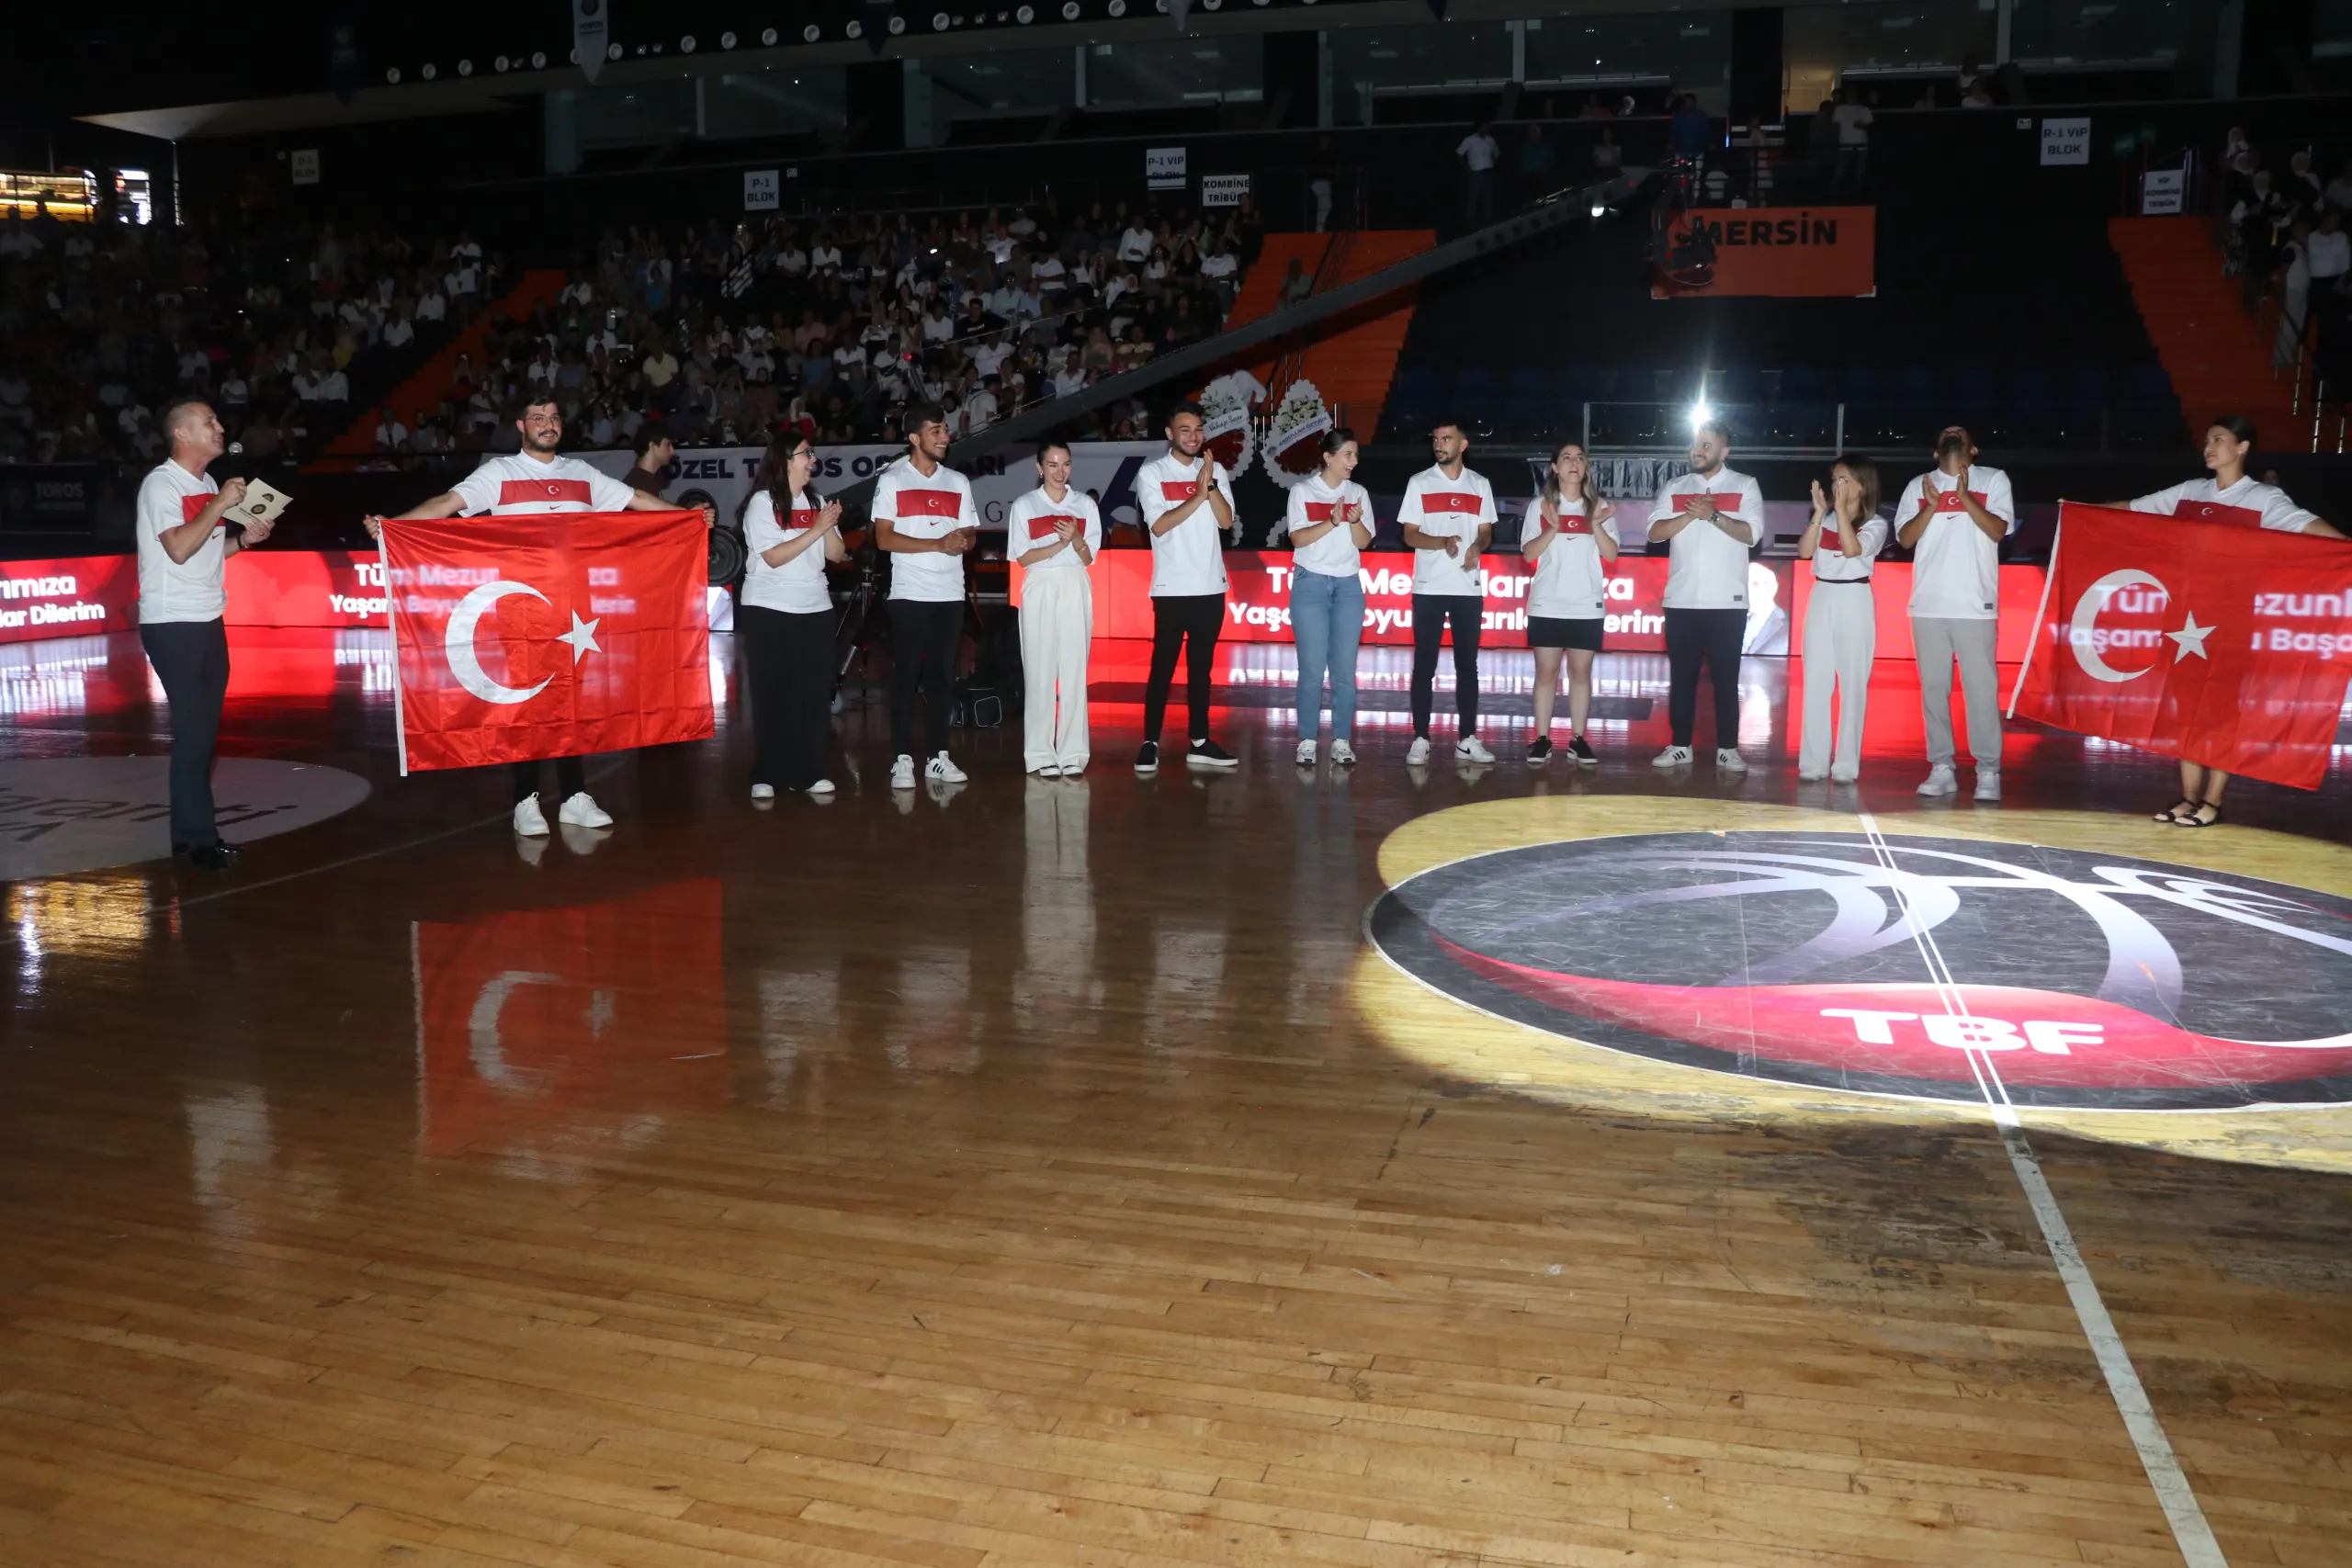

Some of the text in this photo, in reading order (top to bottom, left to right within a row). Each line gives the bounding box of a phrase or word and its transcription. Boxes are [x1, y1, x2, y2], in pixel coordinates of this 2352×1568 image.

[2044, 128, 2088, 139] R-1 VIP
[2048, 144, 2081, 154] BLOK
[1148, 156, 1183, 165] P-1 VIP
[752, 178, 769, 187] P-1
[1204, 178, 1250, 189] KOMBİNE
[747, 192, 775, 202] BLOK
[1208, 193, 1239, 203] TRİBÜ
[30, 600, 106, 625] Dilerim
[1820, 1008, 2105, 1055] TBF
